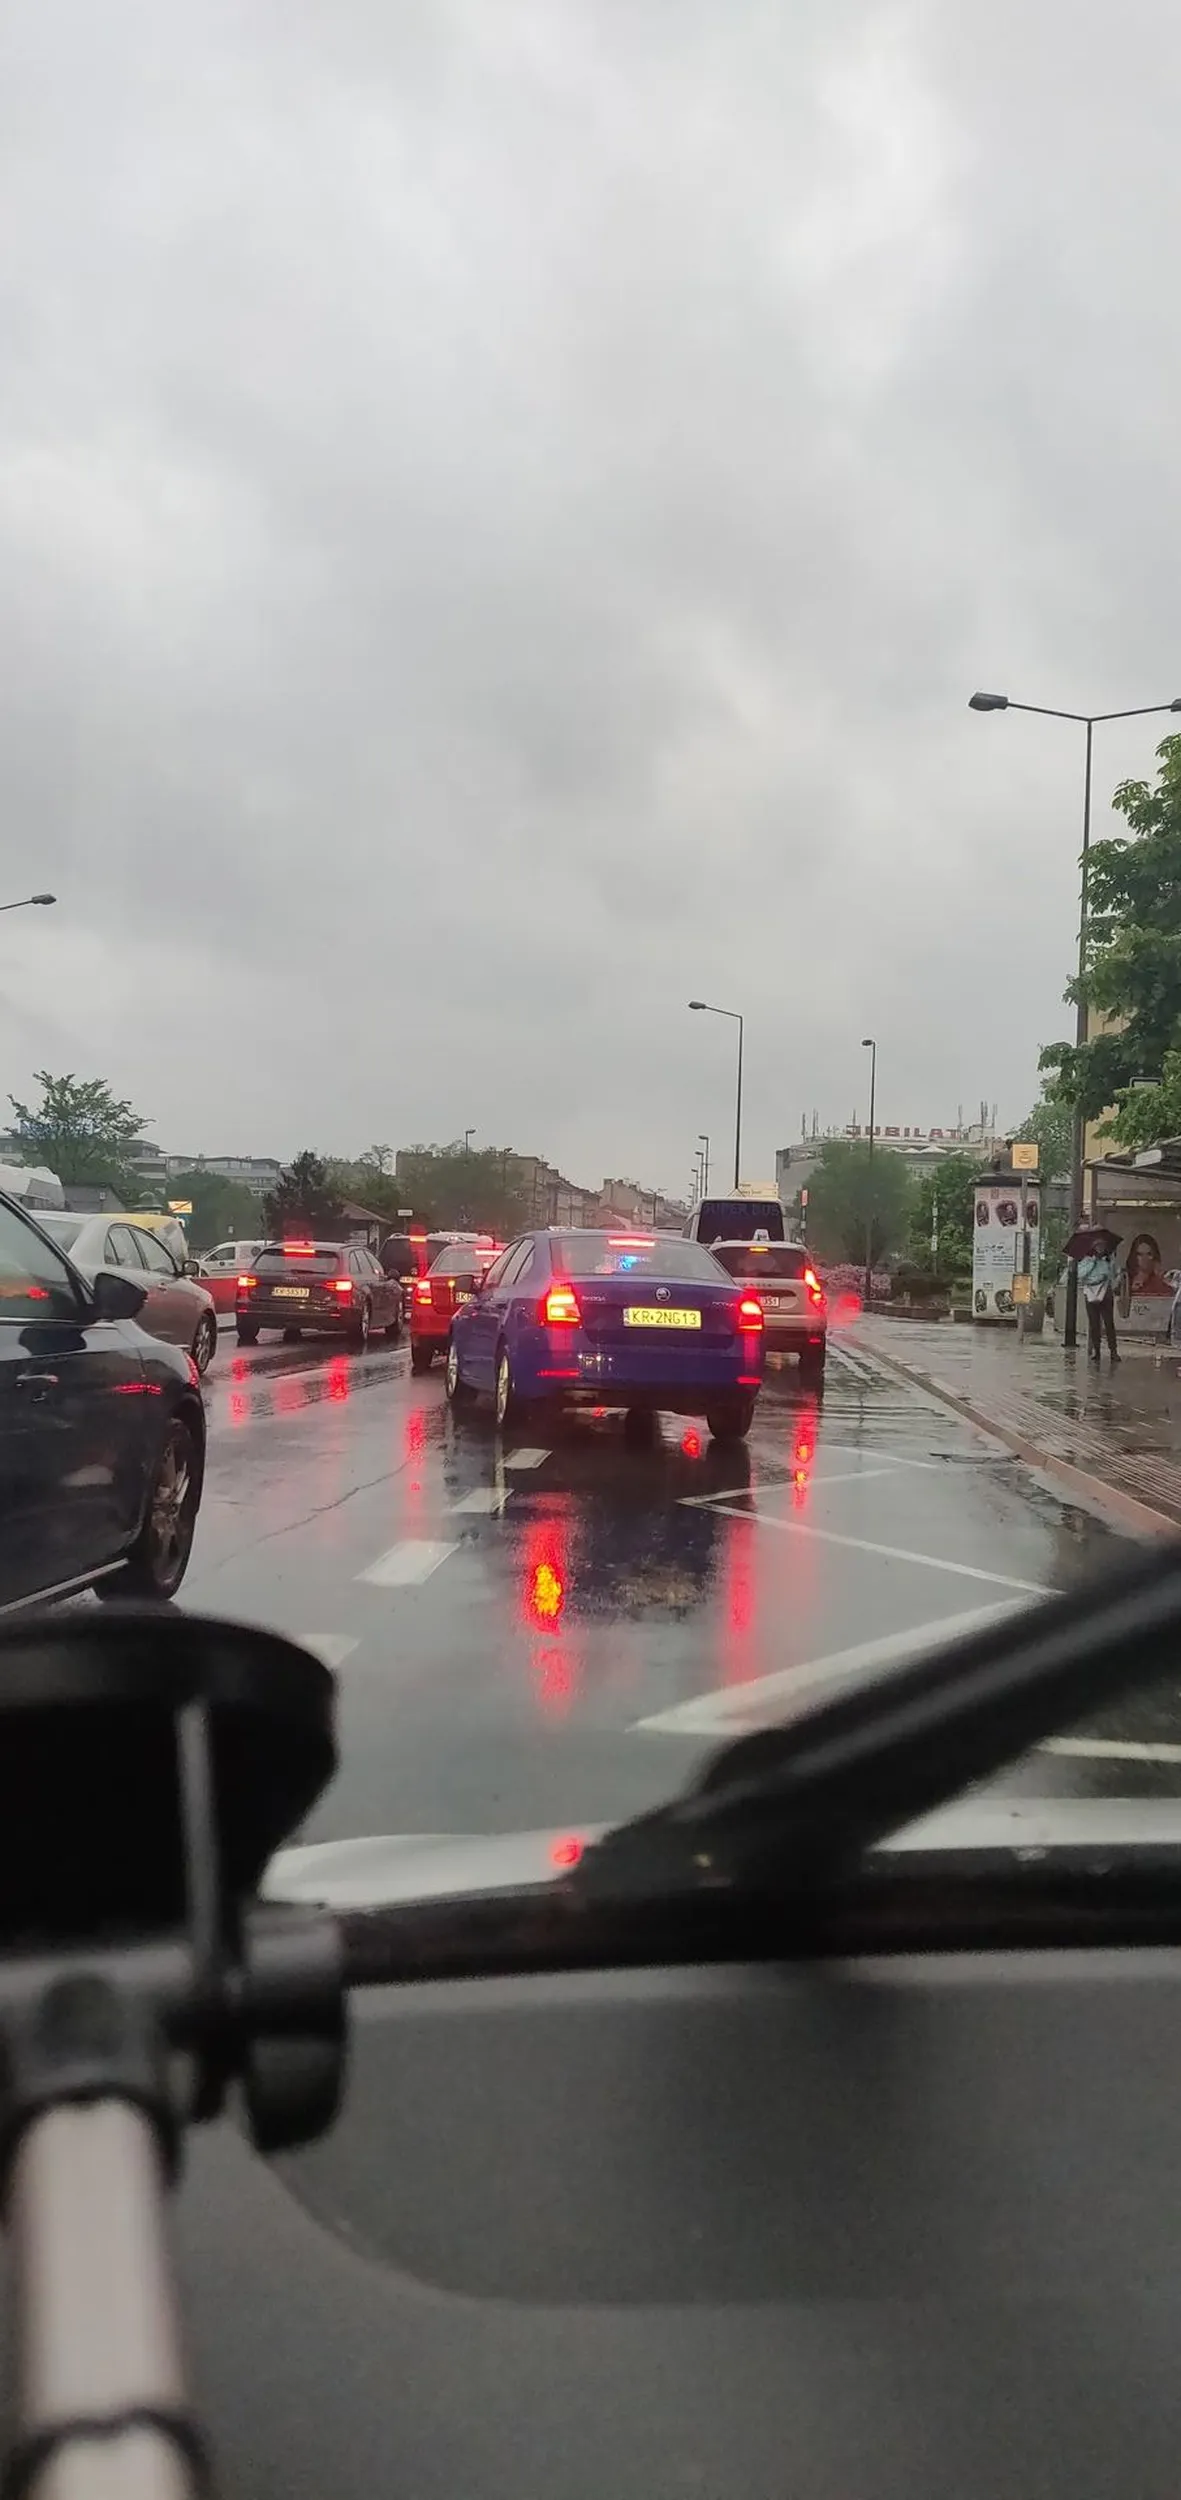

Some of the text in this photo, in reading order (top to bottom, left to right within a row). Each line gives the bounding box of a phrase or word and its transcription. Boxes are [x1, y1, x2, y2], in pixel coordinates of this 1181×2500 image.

[846, 1125, 961, 1139] JUBILAT
[632, 1310, 697, 1325] KR 2NG13
